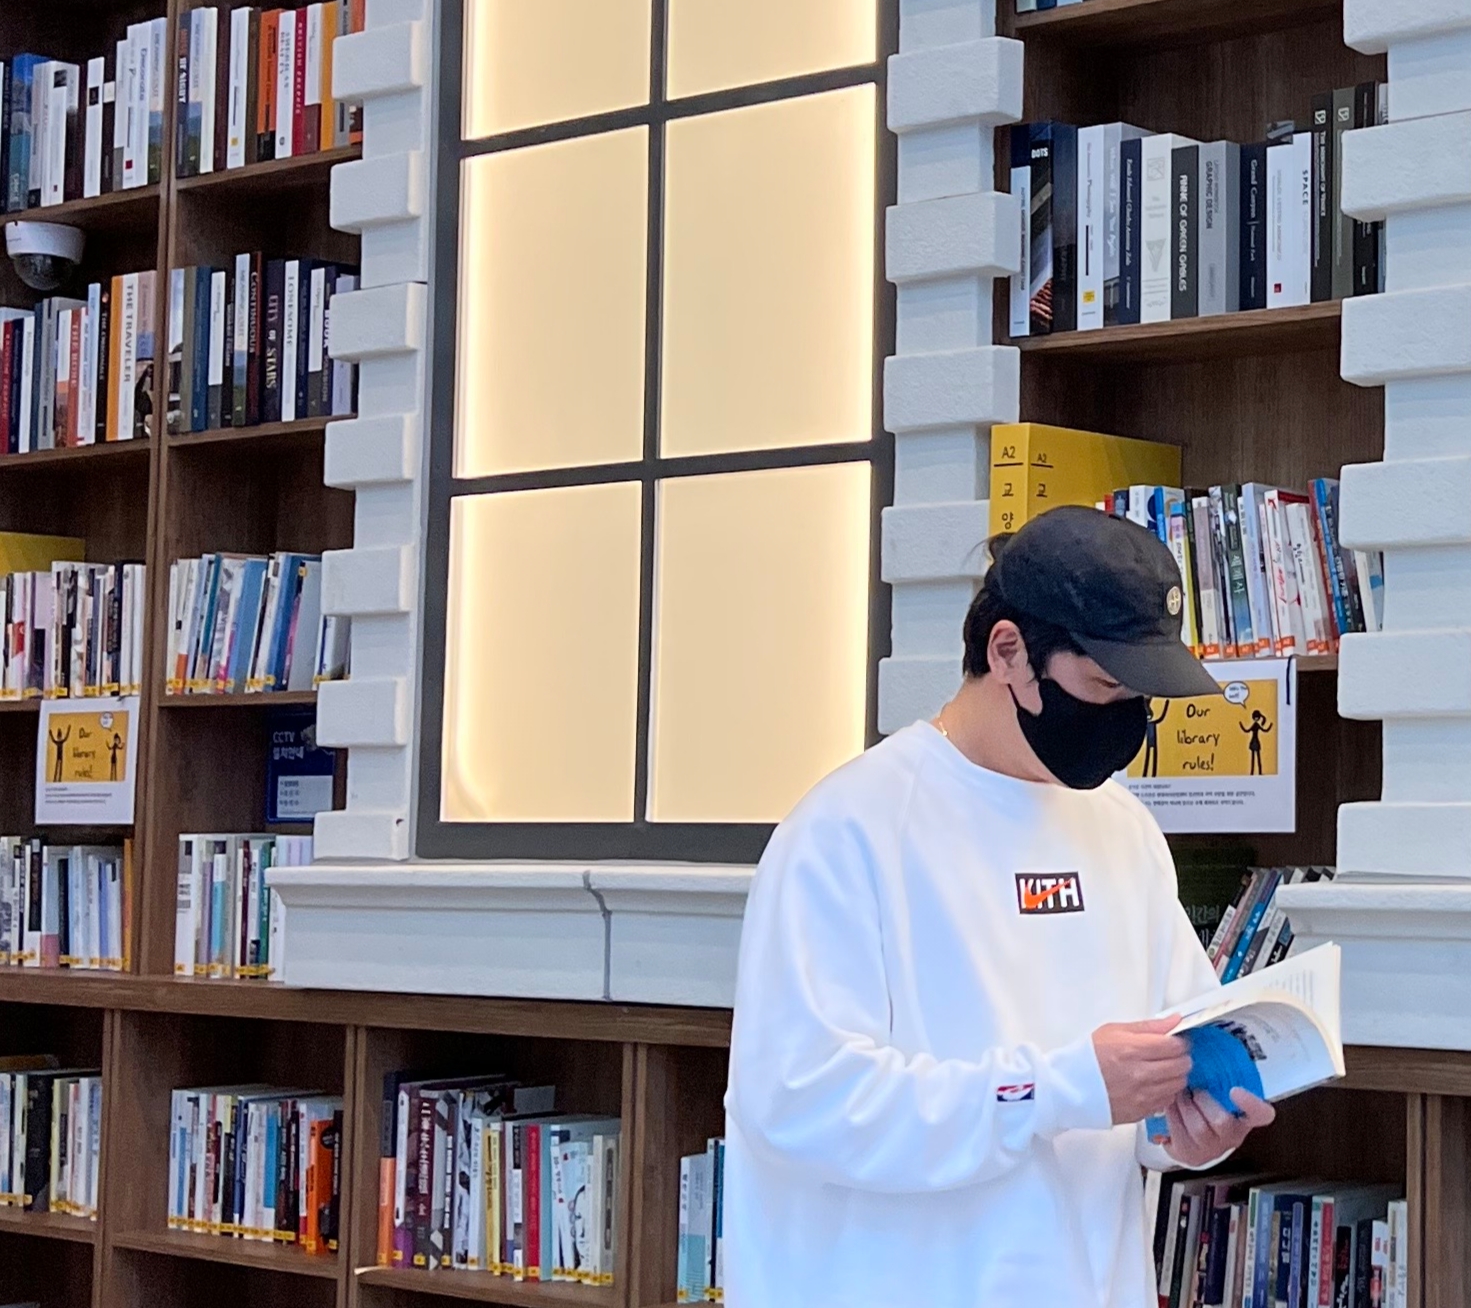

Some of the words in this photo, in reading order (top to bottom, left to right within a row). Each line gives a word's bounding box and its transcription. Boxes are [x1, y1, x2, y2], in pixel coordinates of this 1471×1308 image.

[1301, 169, 1309, 205] SPACE
[1205, 198, 1213, 229] DESIGN
[123, 284, 133, 311] THE
[268, 295, 279, 322] CITY
[123, 314, 133, 383] TRAVELER
[265, 347, 277, 389] STARS
[1002, 446, 1016, 459] A2
[1037, 454, 1047, 463] A2
[1186, 703, 1210, 719] Our
[273, 731, 295, 743] CCTV
[1177, 729, 1220, 747] library
[1183, 753, 1214, 771] rules!
[1019, 877, 1080, 910] KITH
